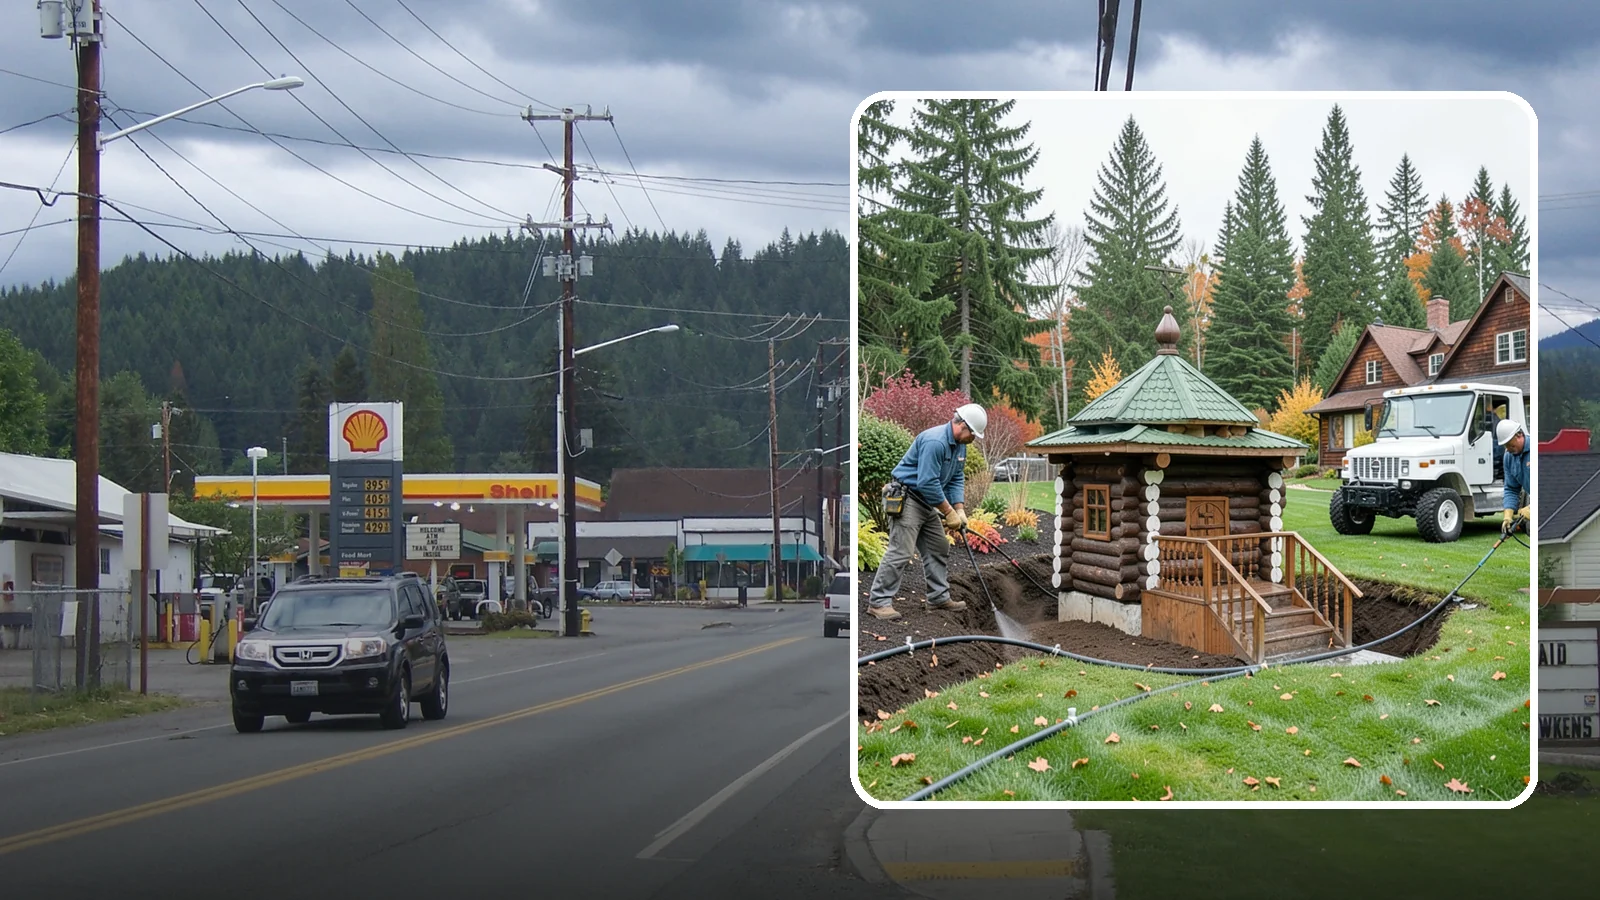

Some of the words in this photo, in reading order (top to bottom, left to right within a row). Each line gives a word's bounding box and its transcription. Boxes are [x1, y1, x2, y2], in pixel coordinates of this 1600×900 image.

[365, 480, 383, 490] 395
[490, 484, 547, 498] Shell
[365, 494, 383, 504] 405
[365, 508, 383, 518] 415
[365, 522, 383, 532] 429
